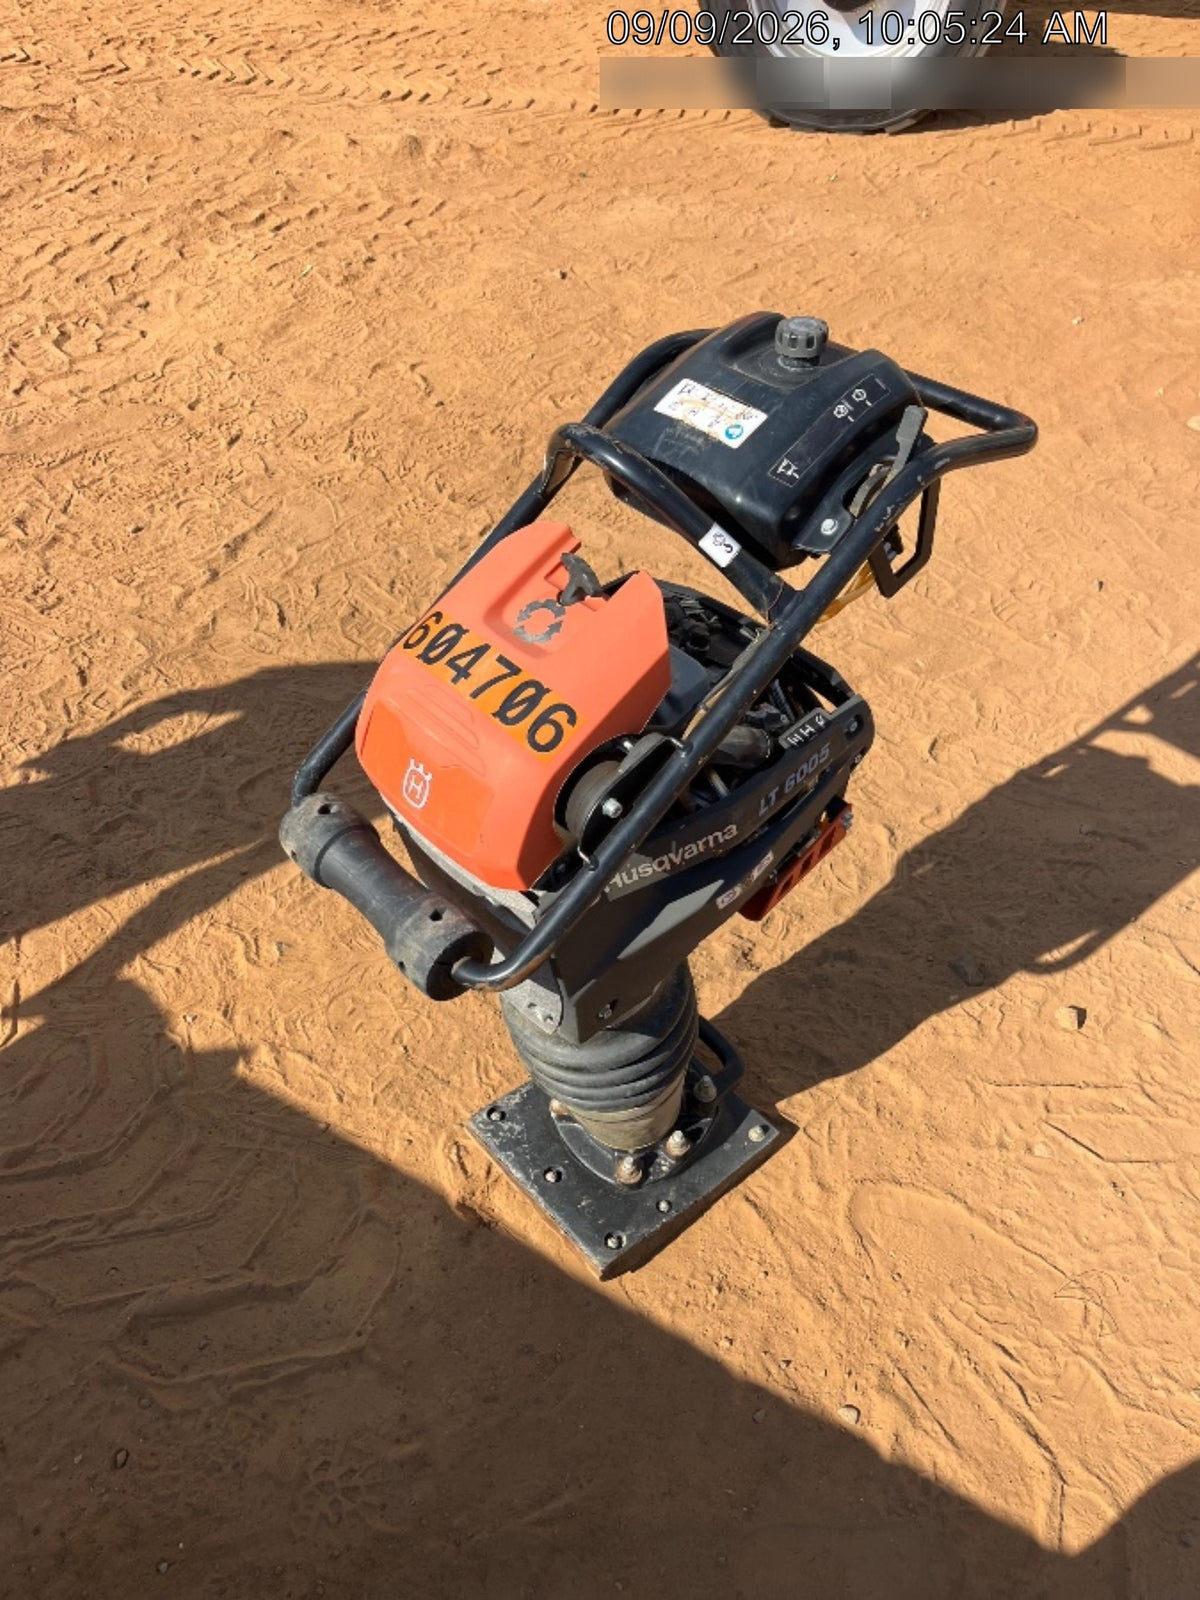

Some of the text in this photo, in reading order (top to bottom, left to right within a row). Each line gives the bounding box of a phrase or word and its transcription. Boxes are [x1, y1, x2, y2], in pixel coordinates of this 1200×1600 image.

[403, 611, 577, 753] 604706
[758, 743, 831, 816] LT 6005
